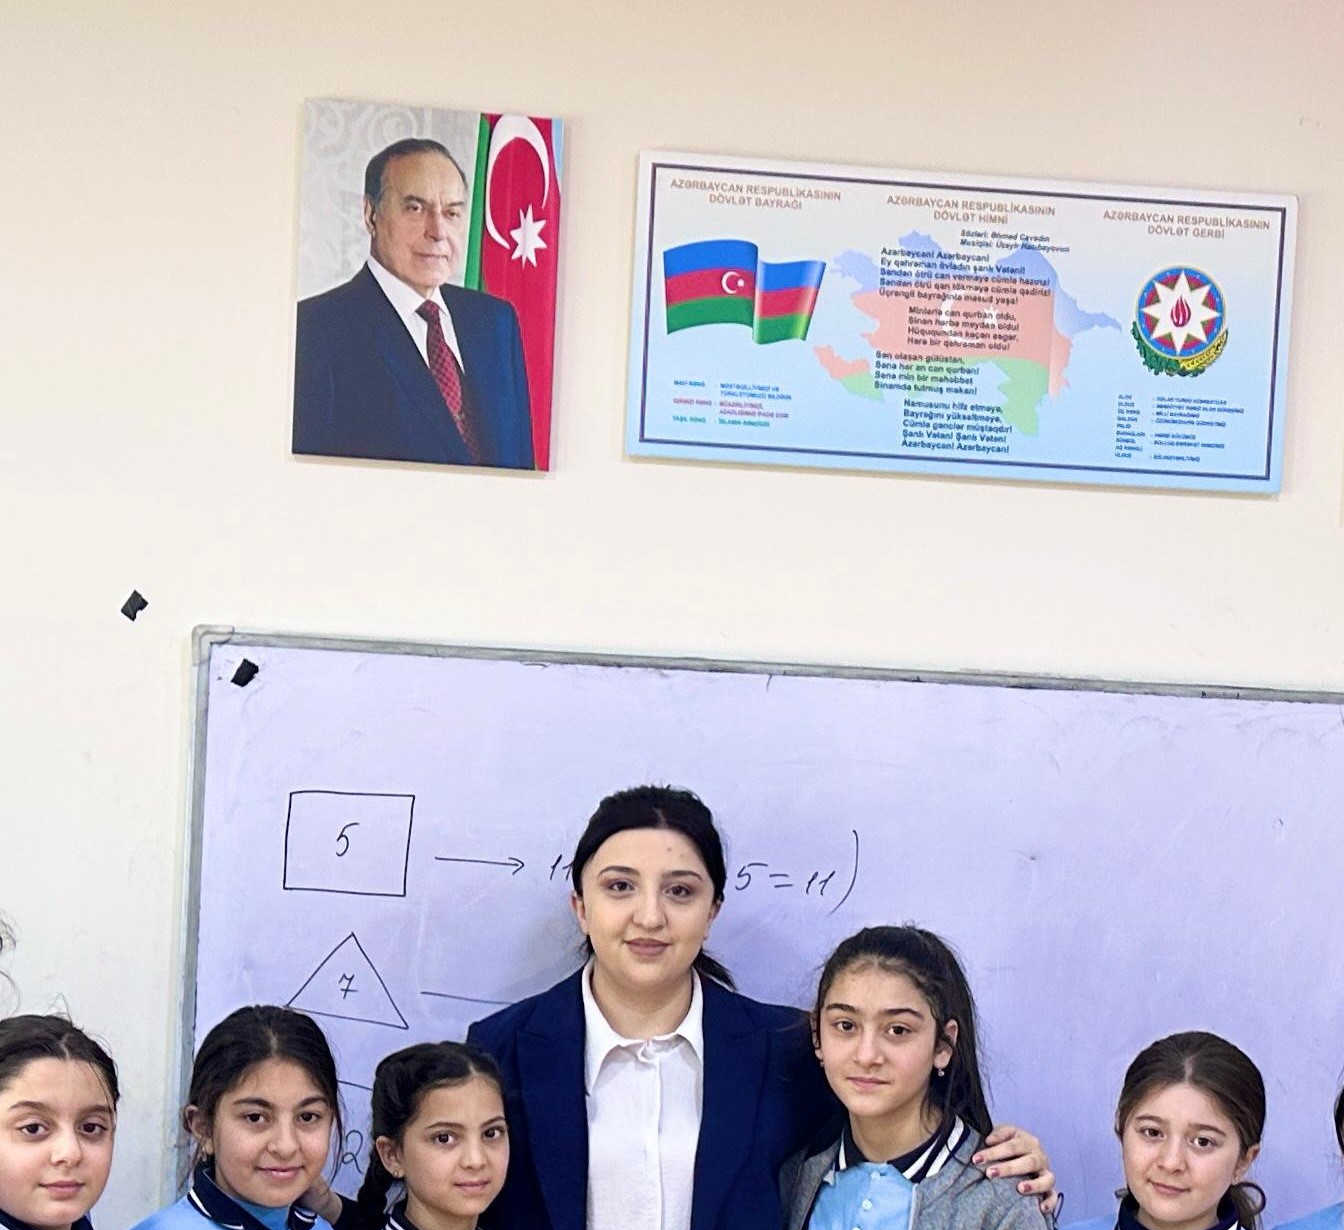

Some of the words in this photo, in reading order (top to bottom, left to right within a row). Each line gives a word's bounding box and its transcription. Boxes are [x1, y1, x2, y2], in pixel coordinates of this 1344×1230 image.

[670, 179, 743, 194] AZƏRBAYCAN
[709, 193, 753, 206] DÖVLƏT
[887, 195, 959, 209] AZƏRBAYCAN
[934, 210, 975, 222] DÖVLƏT
[1104, 210, 1174, 224] AZƏRBAYCAN
[1148, 224, 1190, 237] DÖVLƏT
[336, 822, 360, 857] 5
[338, 973, 358, 1000] 7
